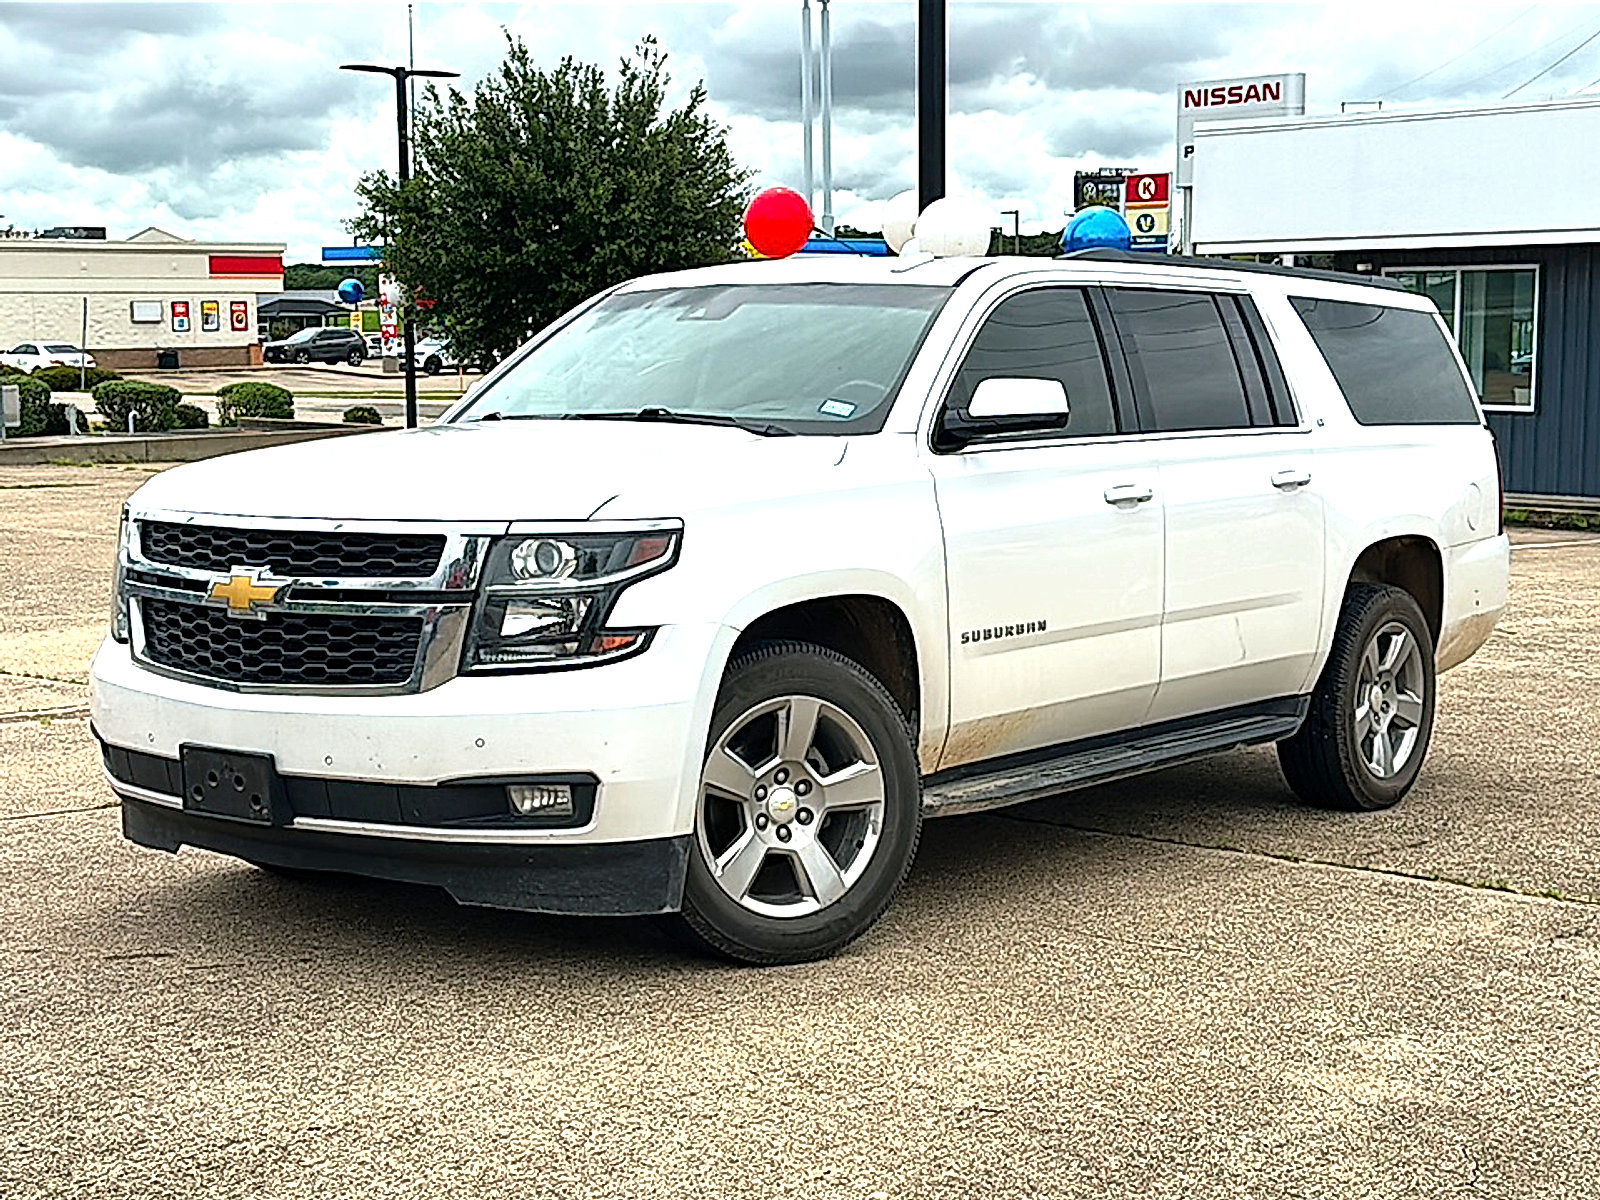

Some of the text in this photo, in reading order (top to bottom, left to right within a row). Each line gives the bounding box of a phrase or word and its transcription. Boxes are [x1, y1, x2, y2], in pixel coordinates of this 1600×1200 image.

[1184, 82, 1280, 108] NISSAN
[1143, 181, 1154, 199] K
[961, 620, 1047, 644] SUBURBAN
